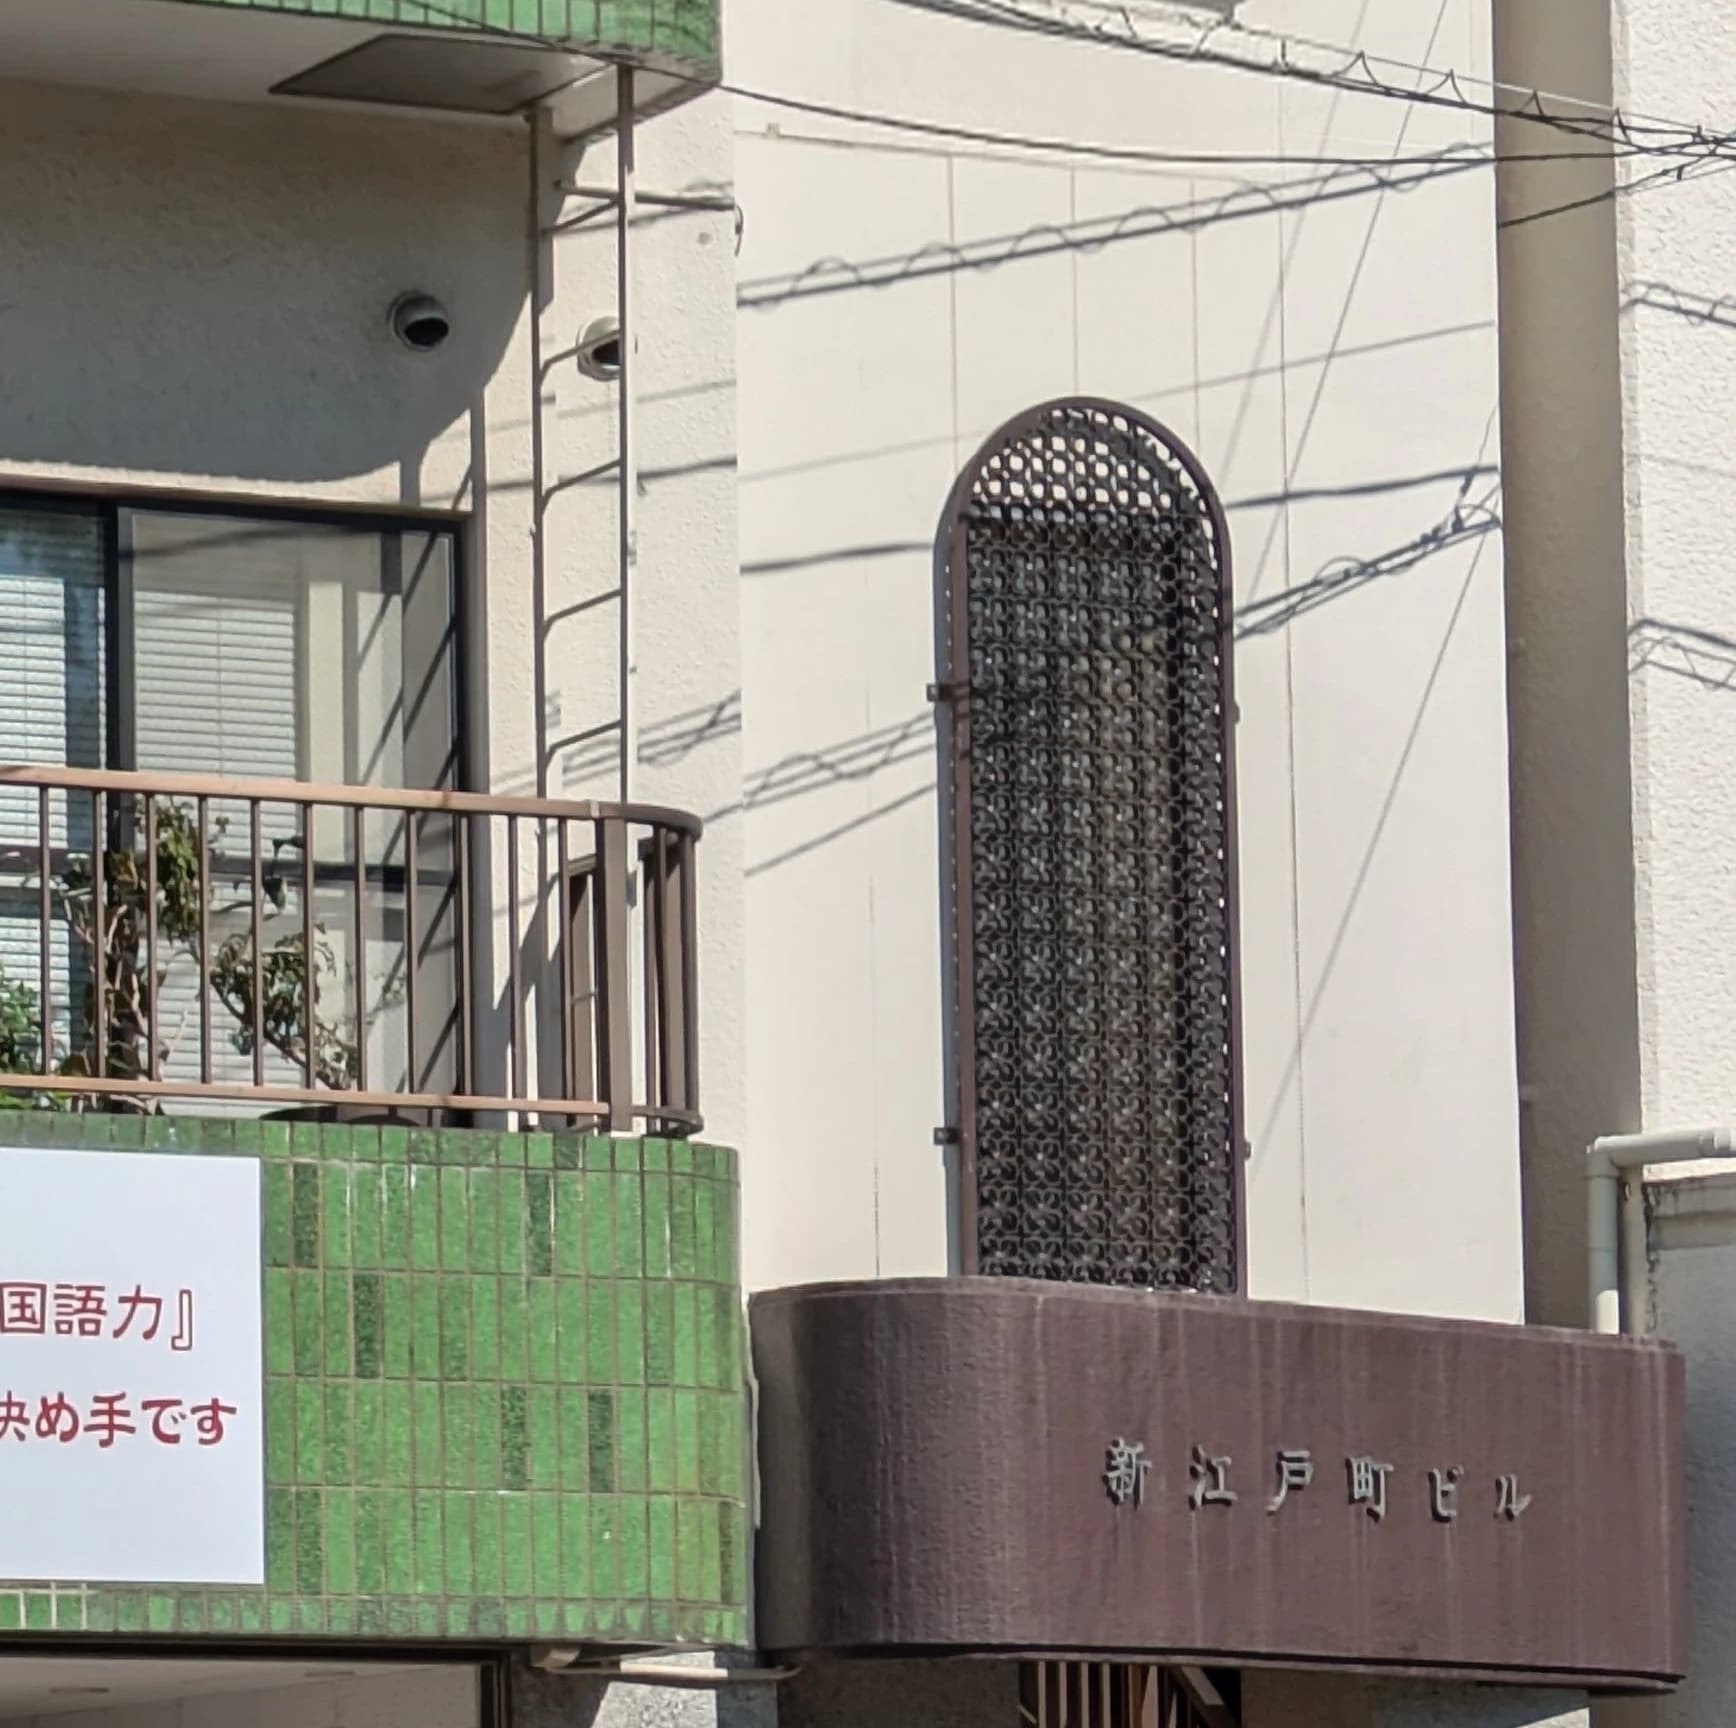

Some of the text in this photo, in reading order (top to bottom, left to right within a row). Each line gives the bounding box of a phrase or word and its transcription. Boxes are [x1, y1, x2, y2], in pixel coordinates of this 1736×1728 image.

[1103, 1437, 1531, 1522] 新江戸町ビル
